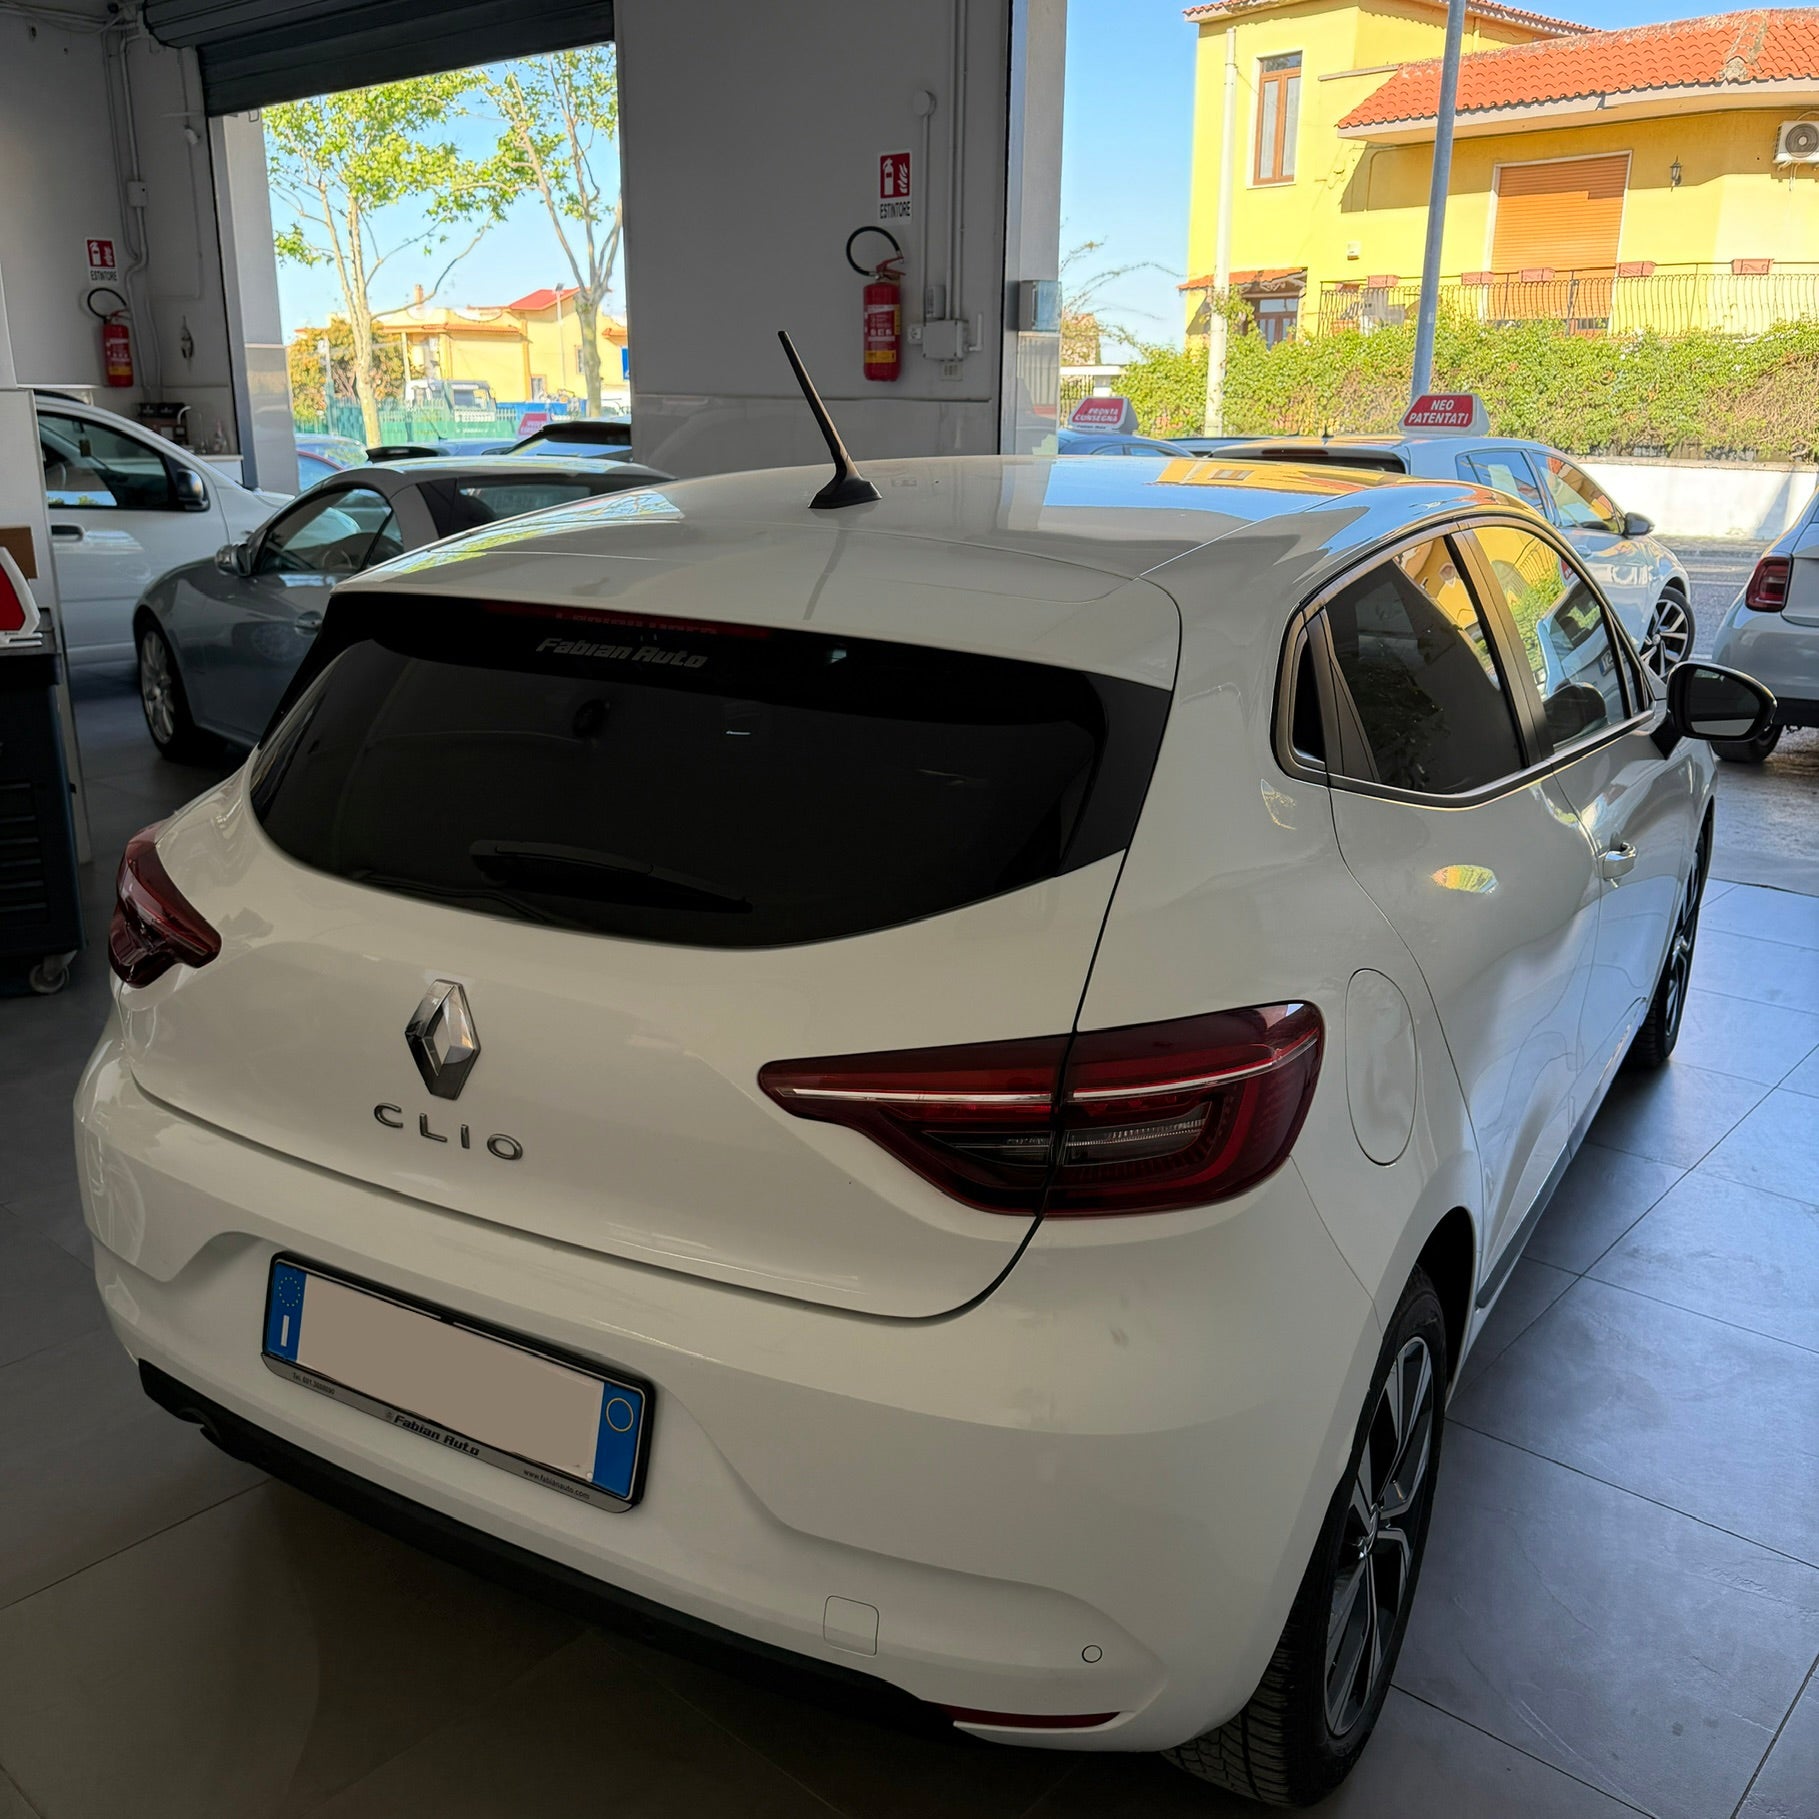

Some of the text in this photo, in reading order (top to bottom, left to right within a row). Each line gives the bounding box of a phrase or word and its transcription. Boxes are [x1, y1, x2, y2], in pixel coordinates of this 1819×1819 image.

[879, 200, 911, 219] ESTINTORE
[1087, 407, 1120, 416] PRONTA
[1430, 399, 1455, 411] NEO
[1074, 414, 1119, 423] CONSEGNA
[1407, 412, 1470, 425] PATENTATI
[535, 637, 709, 669] Fabian Auto
[374, 1102, 524, 1161] CLIO
[393, 1414, 481, 1456] Fabian Auto
